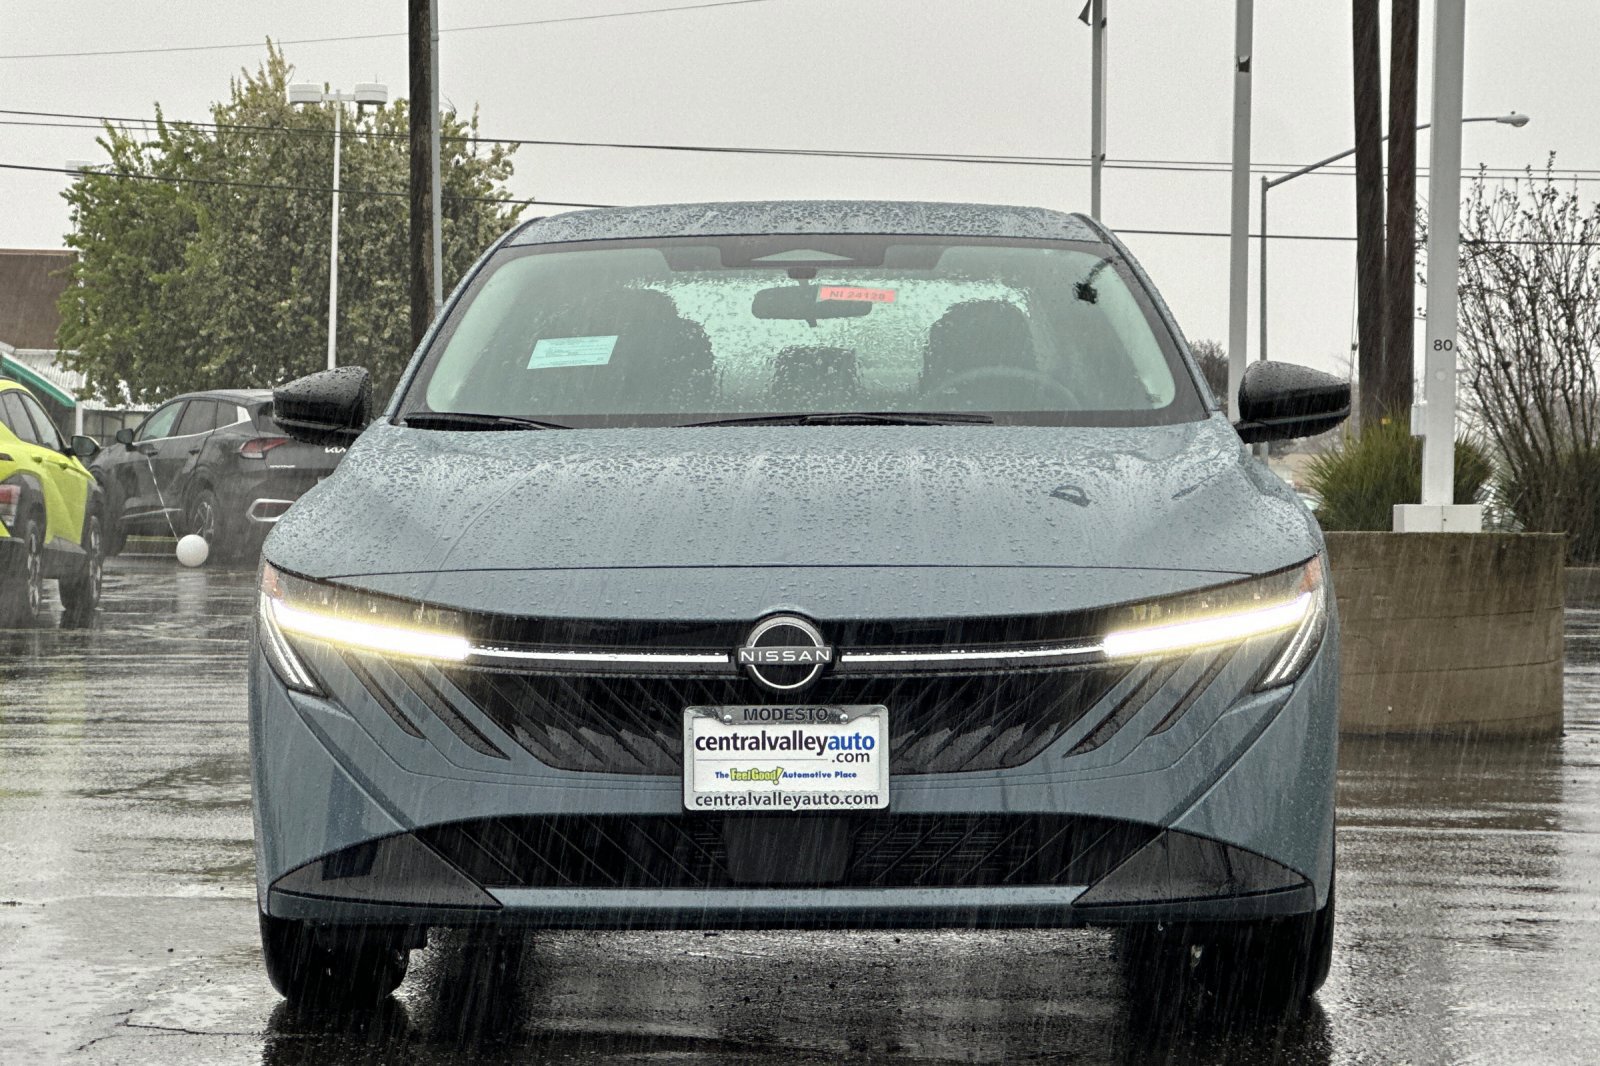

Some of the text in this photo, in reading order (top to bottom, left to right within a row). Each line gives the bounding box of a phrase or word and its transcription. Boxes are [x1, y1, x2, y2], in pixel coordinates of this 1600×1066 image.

[829, 290, 844, 298] NI
[1433, 339, 1453, 351] 80
[740, 650, 830, 662] NISSAN
[743, 707, 829, 722] MODESTO
[695, 730, 875, 756] centralvalleyauto
[831, 752, 870, 763] .com
[714, 771, 730, 779] The
[782, 770, 832, 779] Automotive
[834, 770, 857, 779] Place
[695, 792, 879, 811] centralvalleyauto.com
